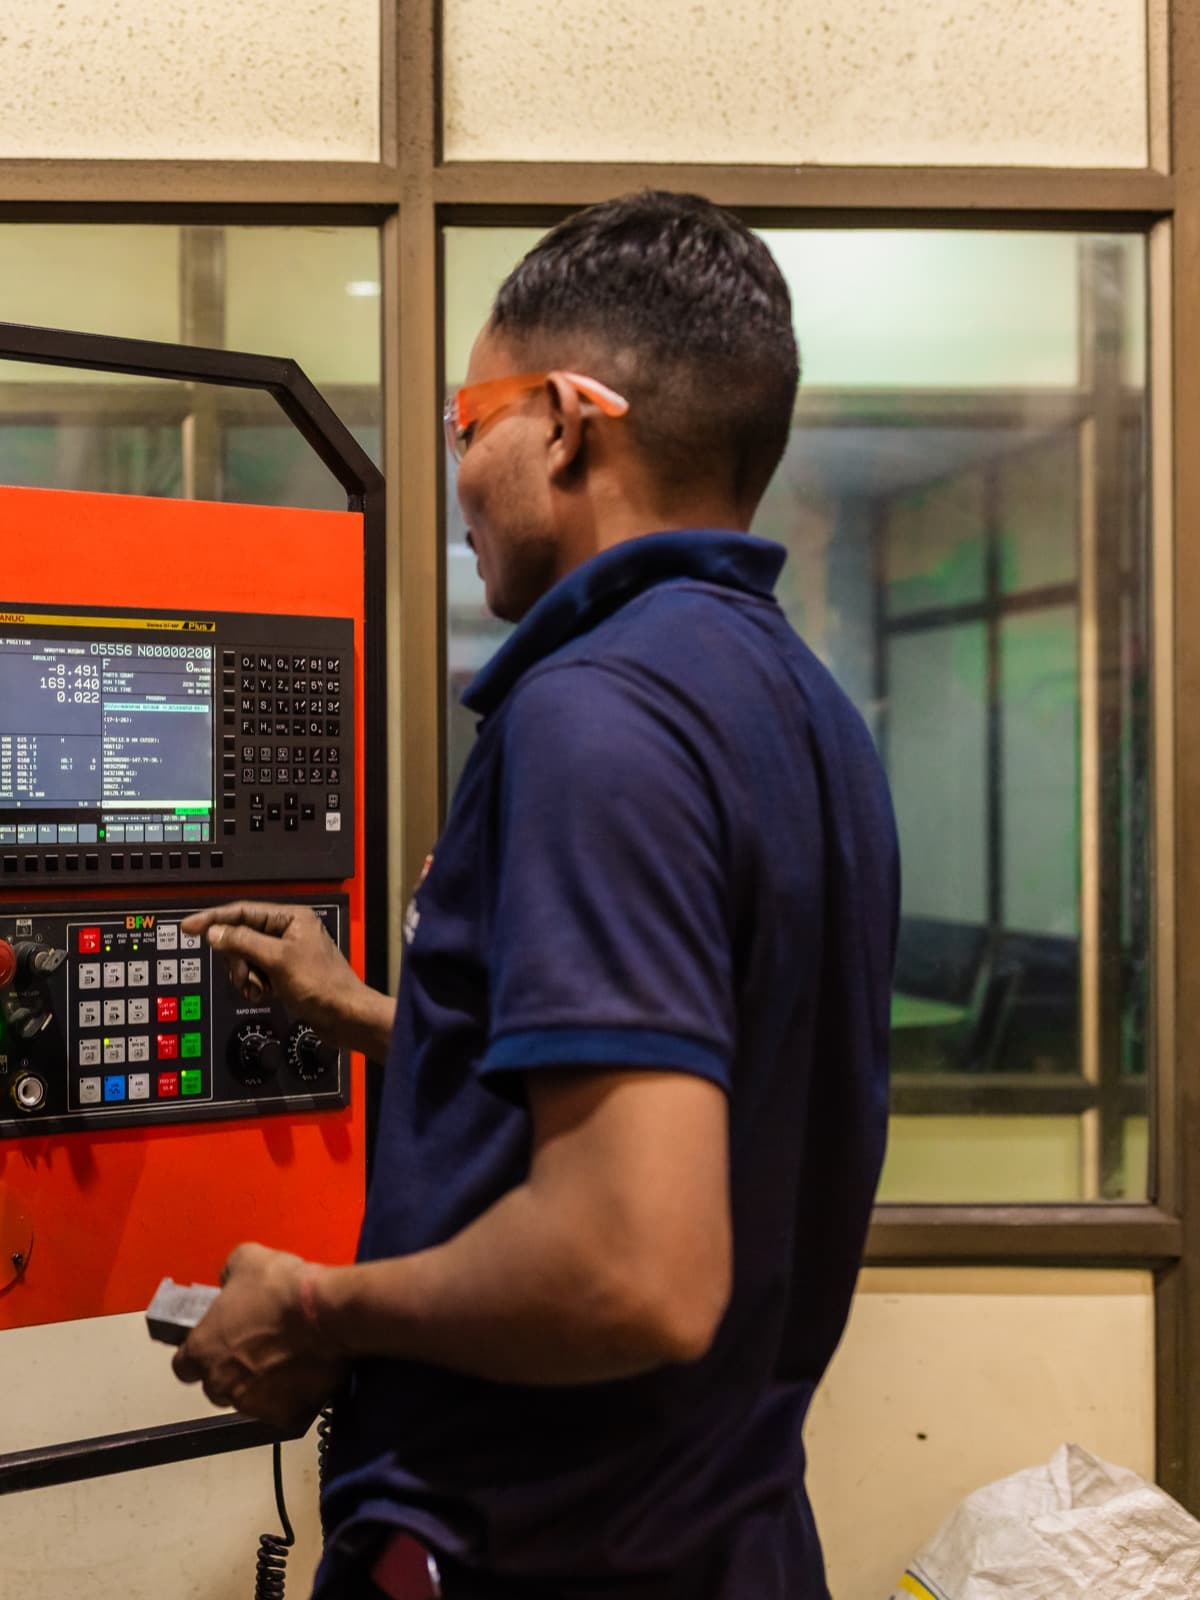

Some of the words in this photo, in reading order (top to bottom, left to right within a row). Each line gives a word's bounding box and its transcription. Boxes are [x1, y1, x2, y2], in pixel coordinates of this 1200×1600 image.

[138, 645, 212, 659] N00000200
[102, 658, 111, 670] F
[260, 658, 266, 667] N
[294, 660, 300, 668] 7
[310, 660, 317, 669] 8
[328, 660, 333, 669] 9
[48, 664, 99, 676] -8.491
[40, 677, 100, 690] 169.440
[278, 680, 283, 689] Z
[294, 681, 300, 689] 4
[311, 681, 317, 690] 5
[56, 691, 100, 704] 0.022
[242, 700, 249, 709] M
[260, 701, 266, 709] S
[278, 702, 283, 710] T
[295, 702, 299, 710] 1
[311, 702, 317, 710] 2
[328, 703, 333, 711] 3
[243, 722, 249, 730] F
[260, 722, 266, 731] H
